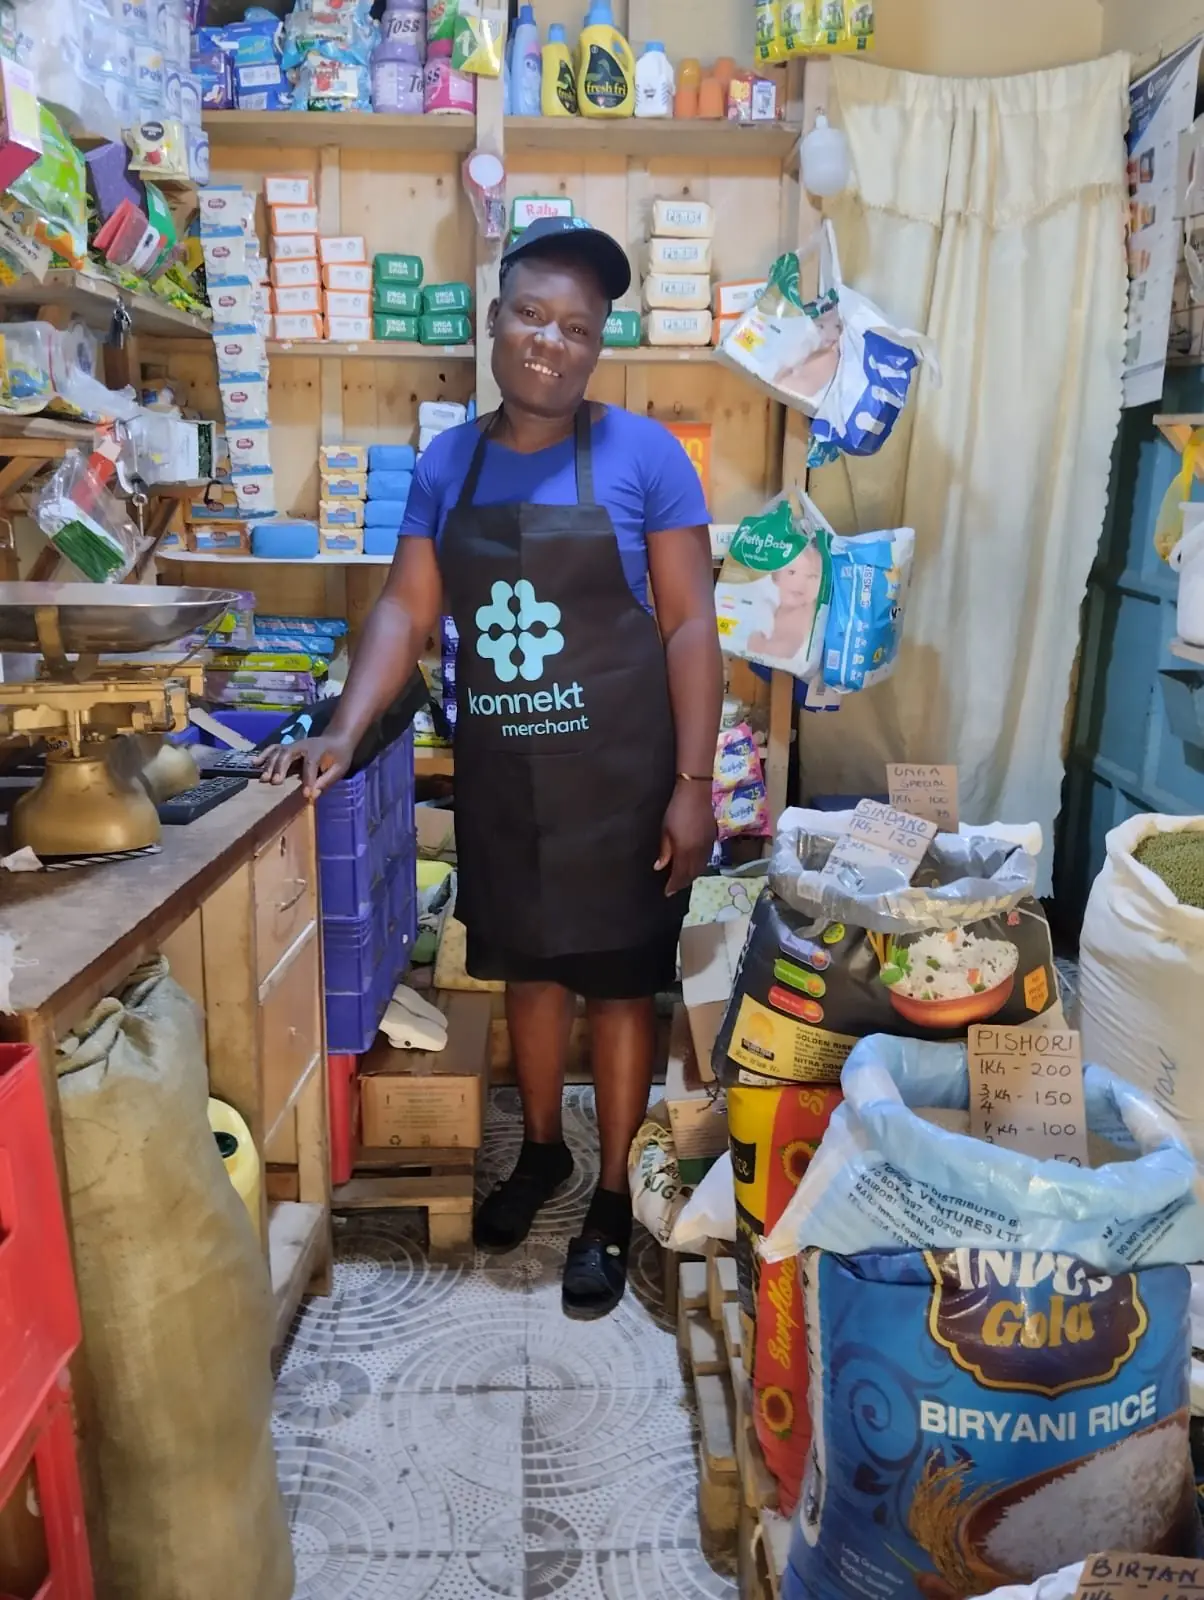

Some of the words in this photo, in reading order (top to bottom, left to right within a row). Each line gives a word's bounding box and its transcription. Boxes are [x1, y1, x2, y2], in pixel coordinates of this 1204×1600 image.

[386, 18, 421, 38] Toss
[409, 74, 424, 93] To
[587, 81, 612, 95] fresh
[614, 82, 627, 97] fri
[525, 203, 558, 218] Raha
[467, 681, 585, 716] konnekt
[501, 715, 590, 737] merchant
[855, 799, 929, 834] SINDANO
[887, 829, 918, 849] 120
[976, 1030, 1073, 1053] PISHORI
[1031, 1061, 1072, 1078] 200
[1035, 1089, 1073, 1107] 150
[1042, 1120, 1078, 1137] 100
[919, 1188, 994, 1236] VENTURES
[919, 1399, 1077, 1443] BIRYANI
[1088, 1384, 1157, 1437] RICE
